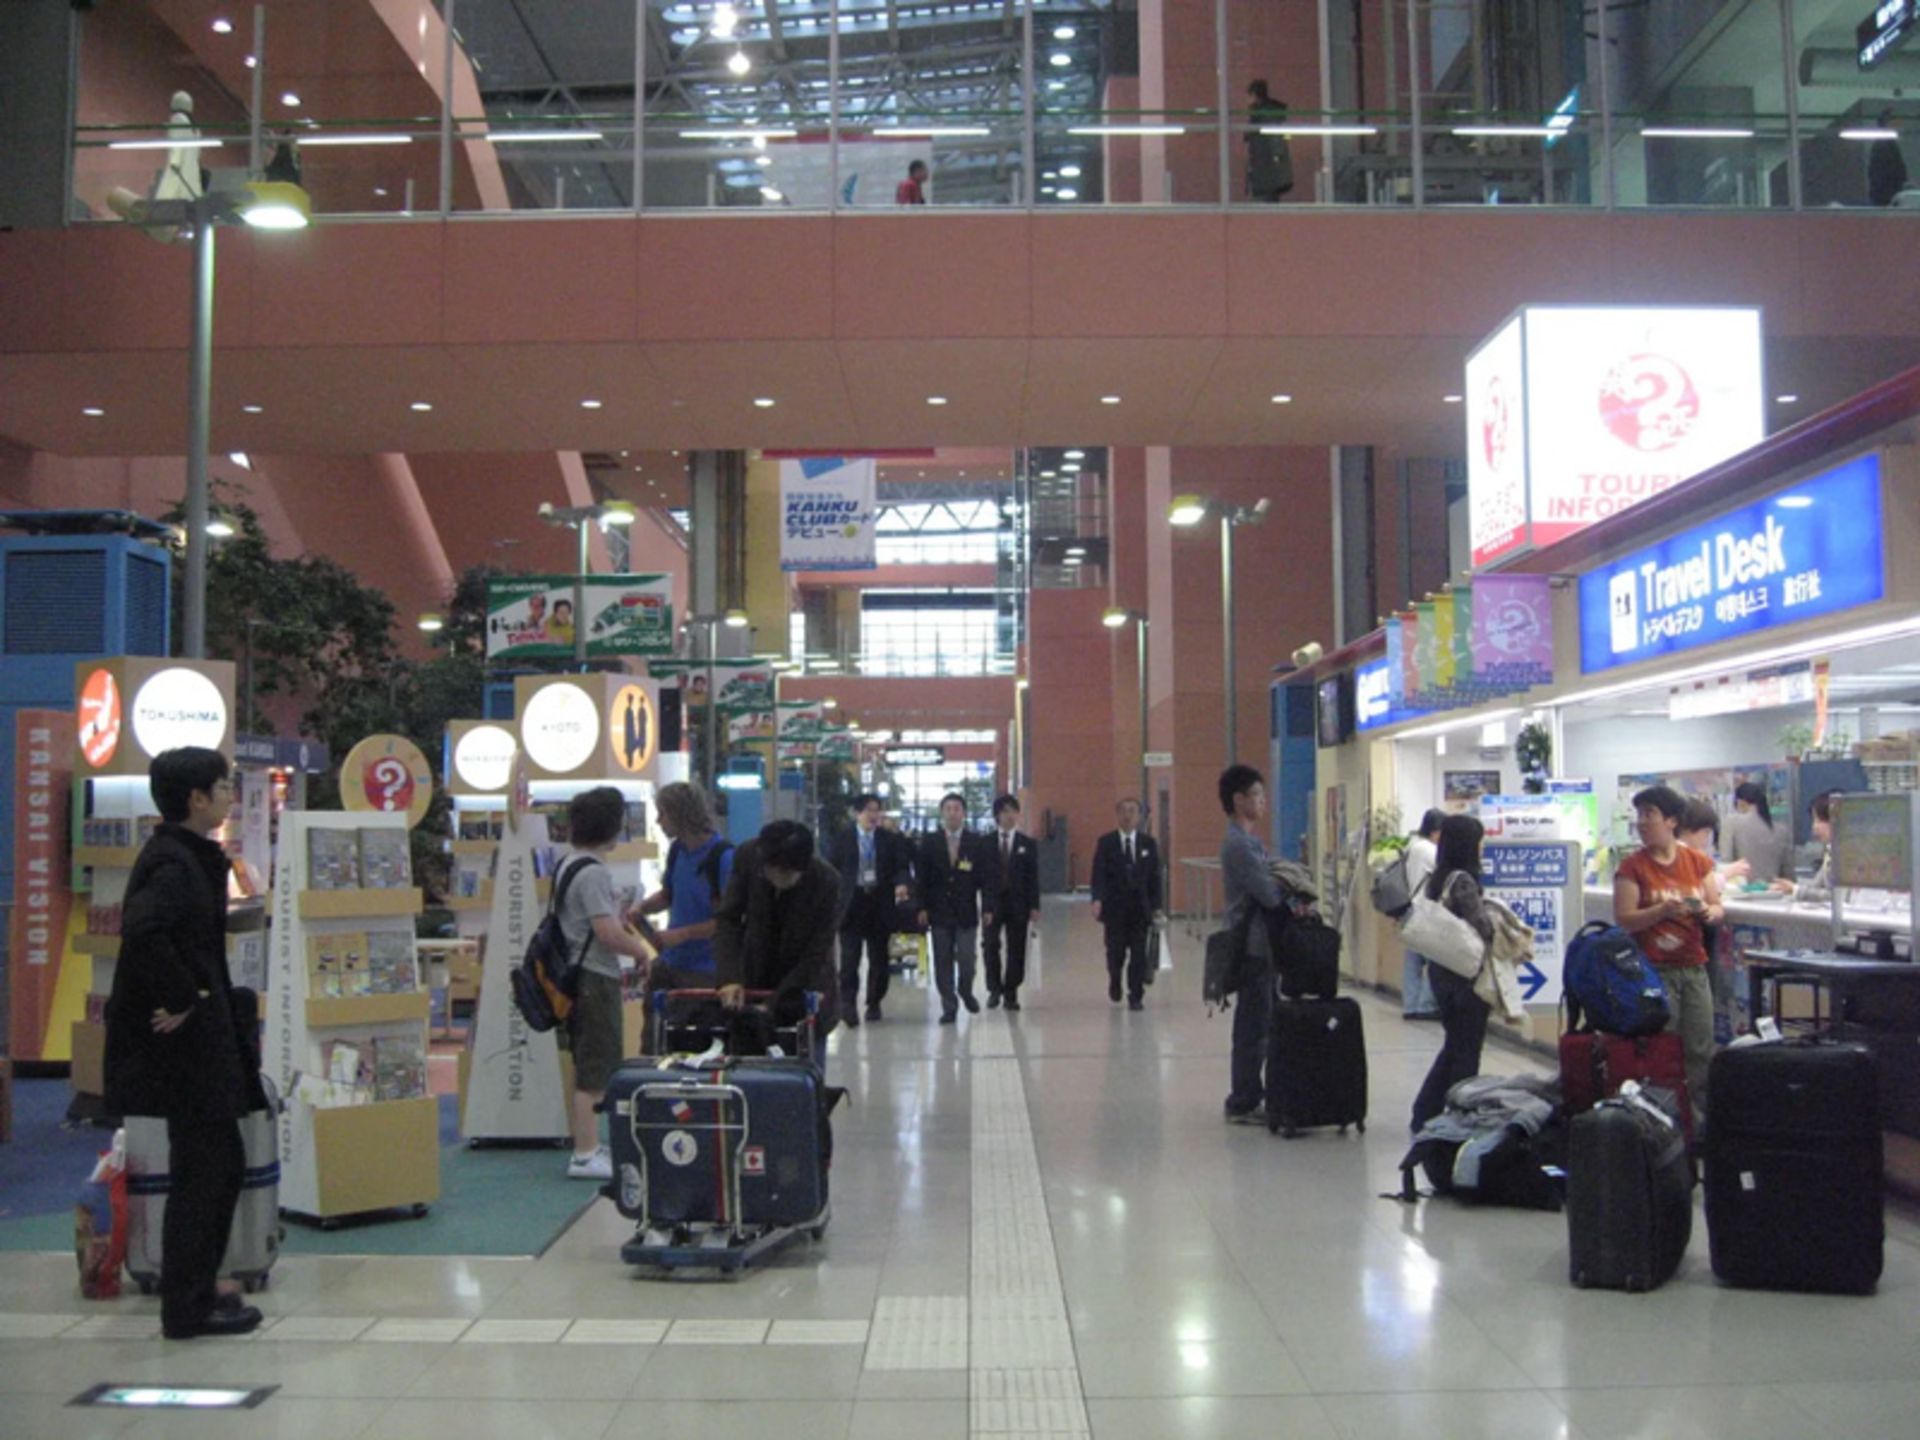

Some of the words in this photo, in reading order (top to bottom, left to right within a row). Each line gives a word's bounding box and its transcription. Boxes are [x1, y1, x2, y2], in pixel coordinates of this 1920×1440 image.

[787, 501, 858, 512] KANKU
[1641, 561, 1711, 613] Travel
[1715, 515, 1786, 590] Desk
[141, 708, 219, 722] TOKUSHIMA
[541, 722, 581, 733] KYOTO
[28, 728, 49, 841] KANSAI
[28, 858, 48, 965] VISION
[281, 864, 292, 976] TOURIST
[508, 856, 523, 947] TOURIST
